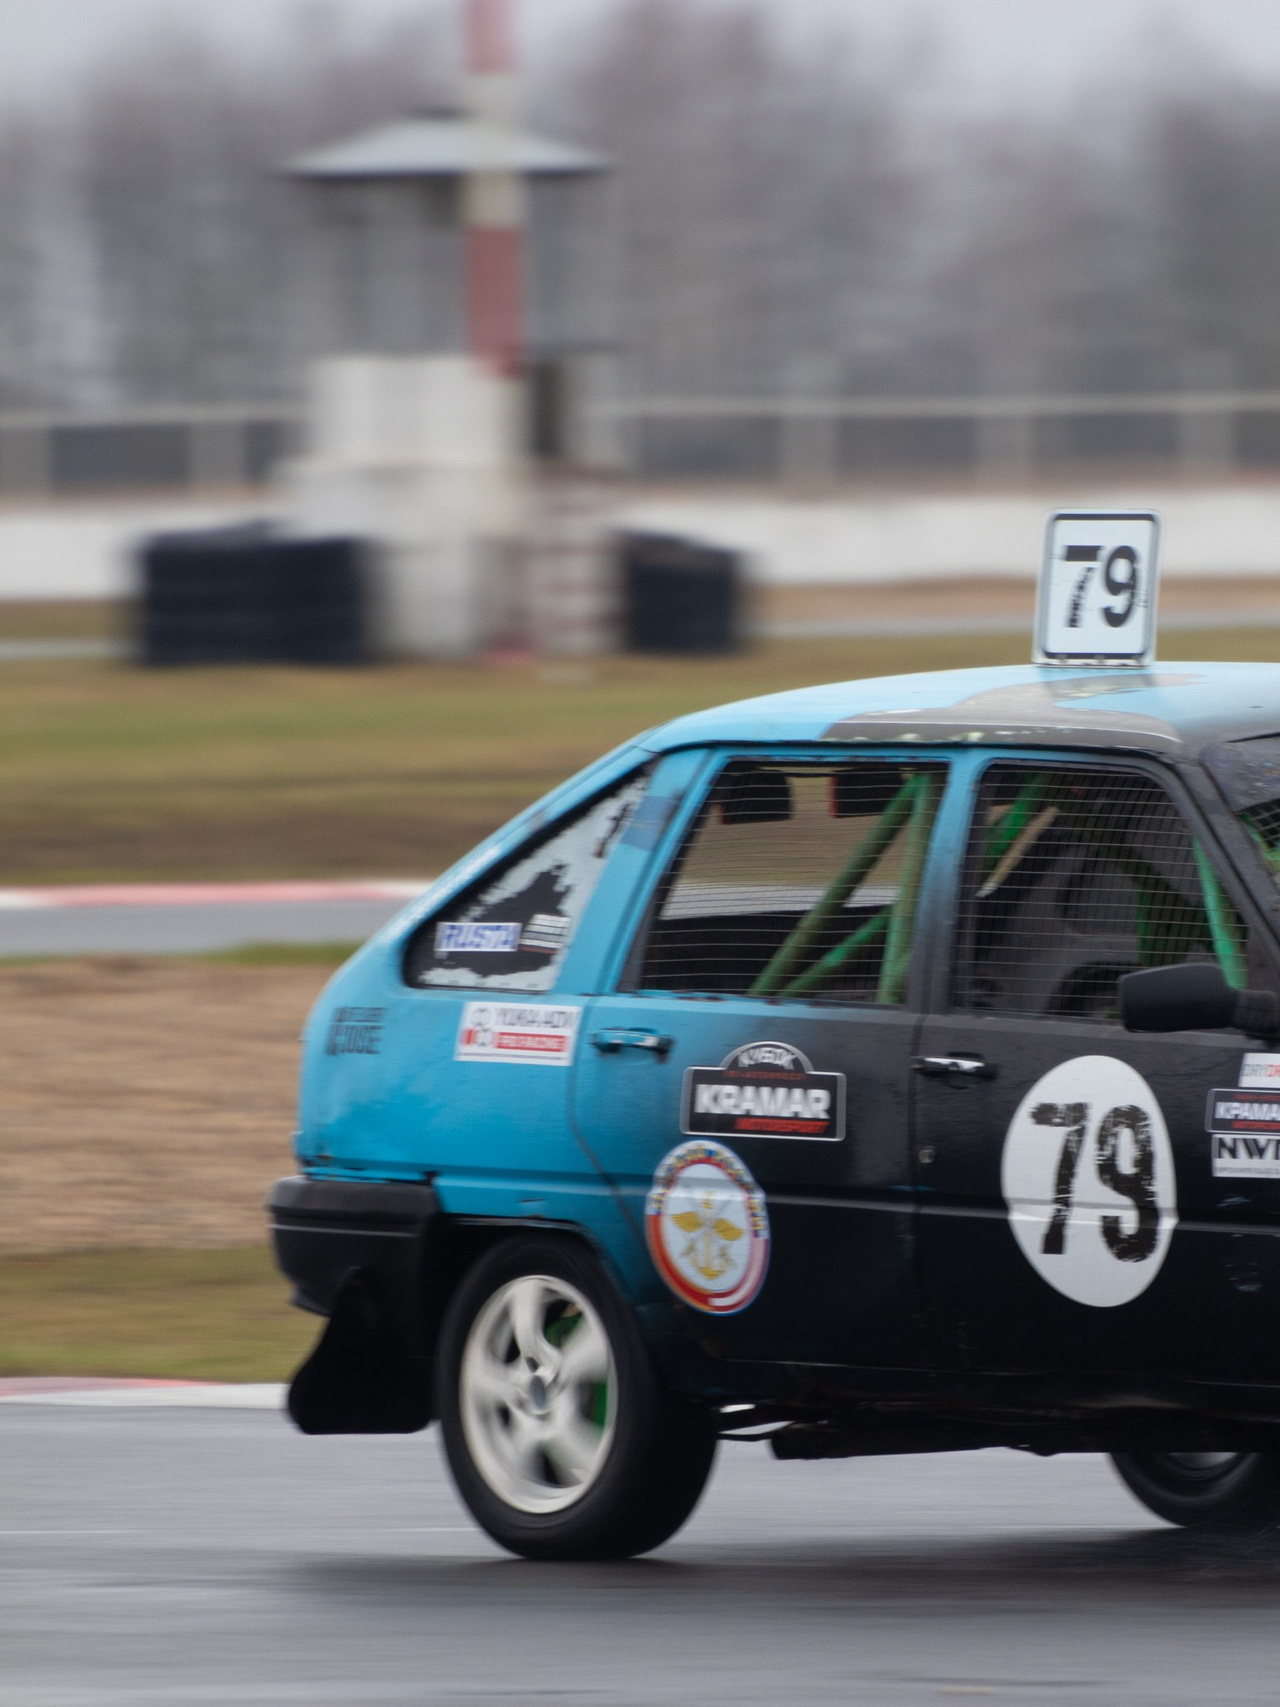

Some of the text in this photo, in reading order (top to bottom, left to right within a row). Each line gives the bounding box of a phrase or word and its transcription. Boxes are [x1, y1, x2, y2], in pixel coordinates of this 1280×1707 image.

[1064, 545, 1139, 628] 79
[694, 1083, 831, 1119] KRAMAR
[1030, 1102, 1160, 1264] 79
